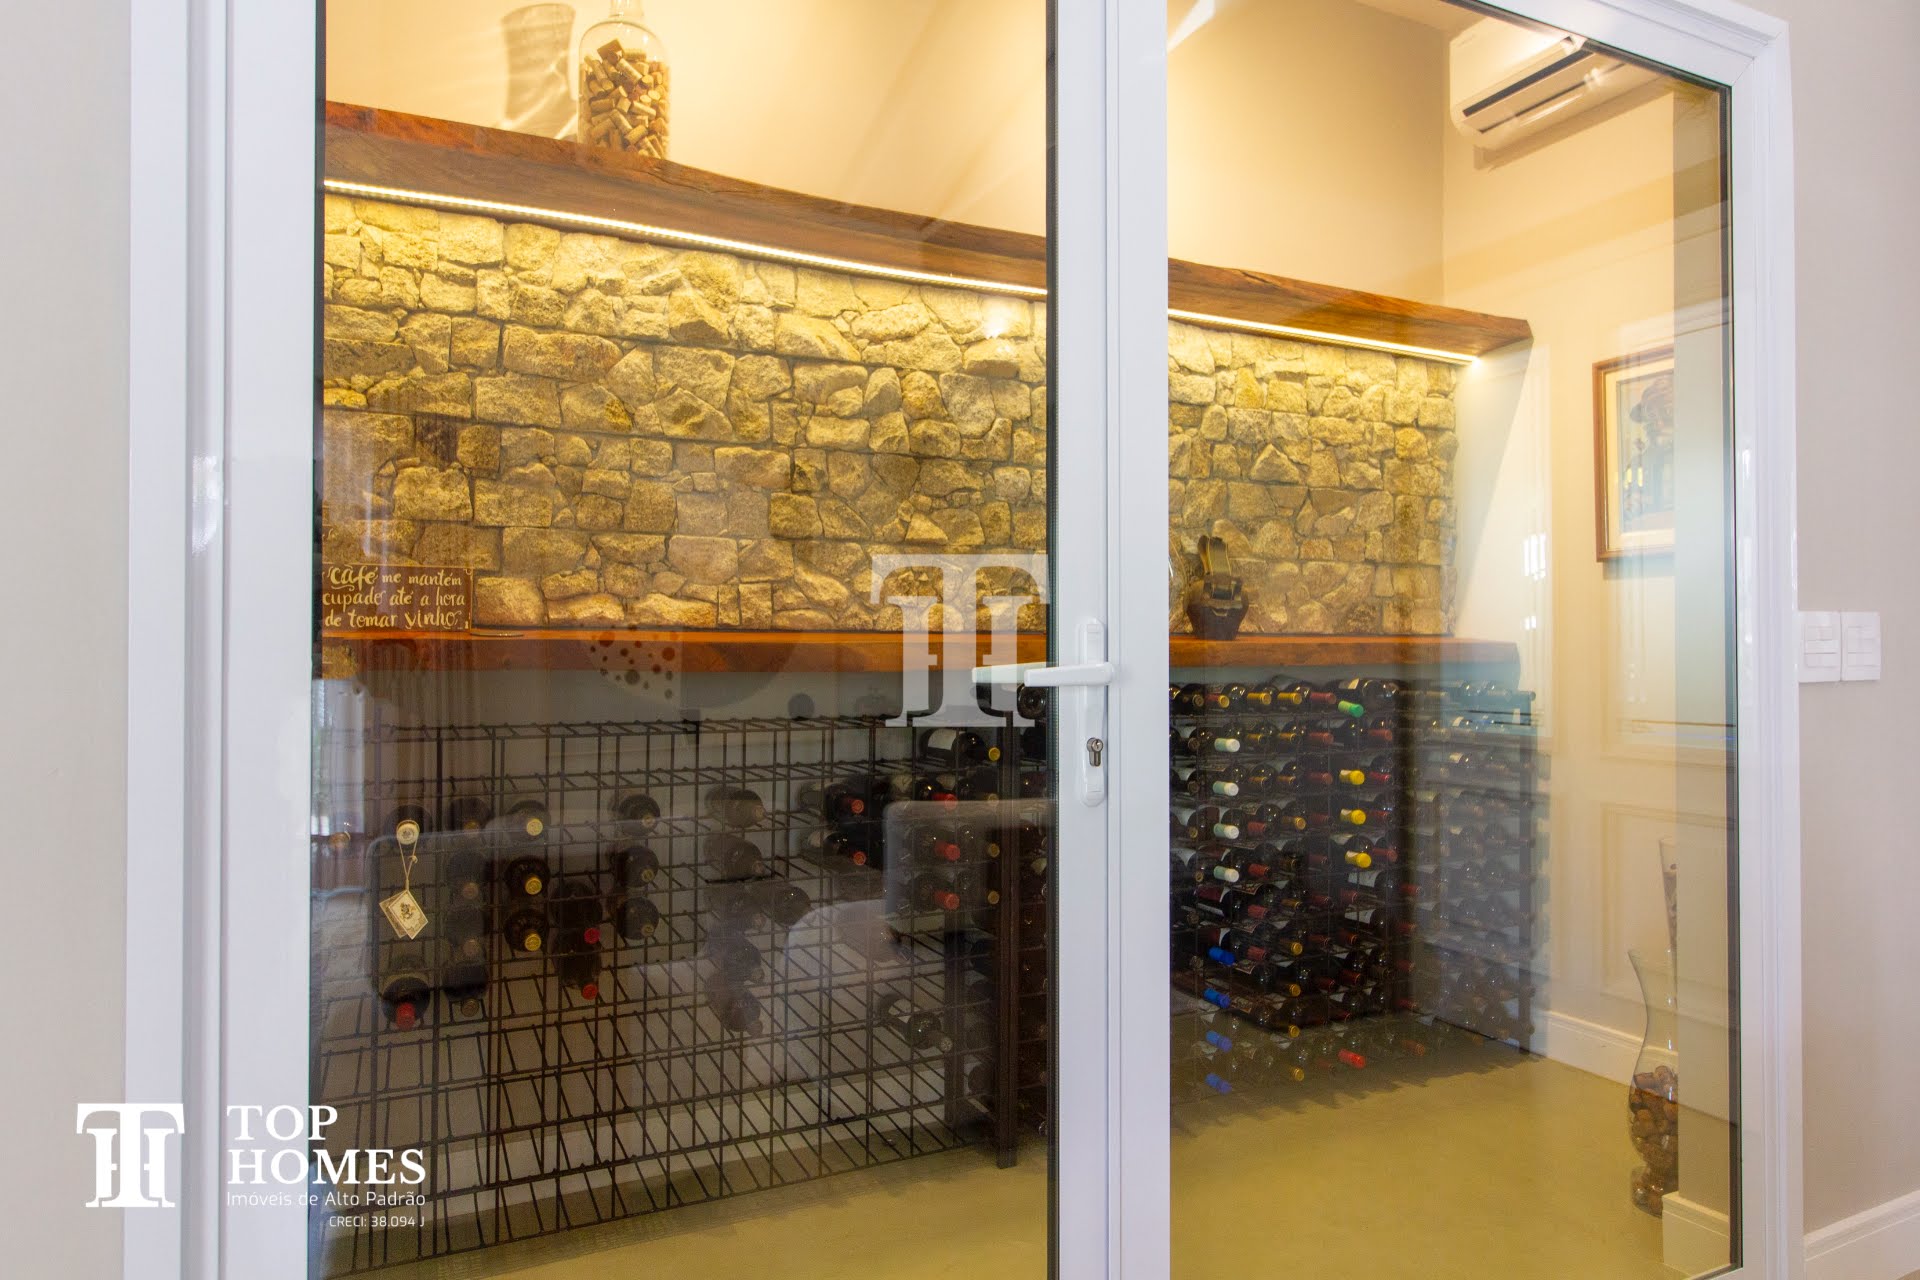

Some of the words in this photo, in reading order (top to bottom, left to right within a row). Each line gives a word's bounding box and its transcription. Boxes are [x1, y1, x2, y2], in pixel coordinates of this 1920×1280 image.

[382, 573, 401, 584] me
[408, 569, 462, 587] mantém
[322, 587, 386, 612] cupado
[389, 587, 414, 606] até
[420, 595, 431, 606] a
[435, 587, 466, 606] hora
[325, 608, 342, 627] de
[348, 609, 398, 628] tomar
